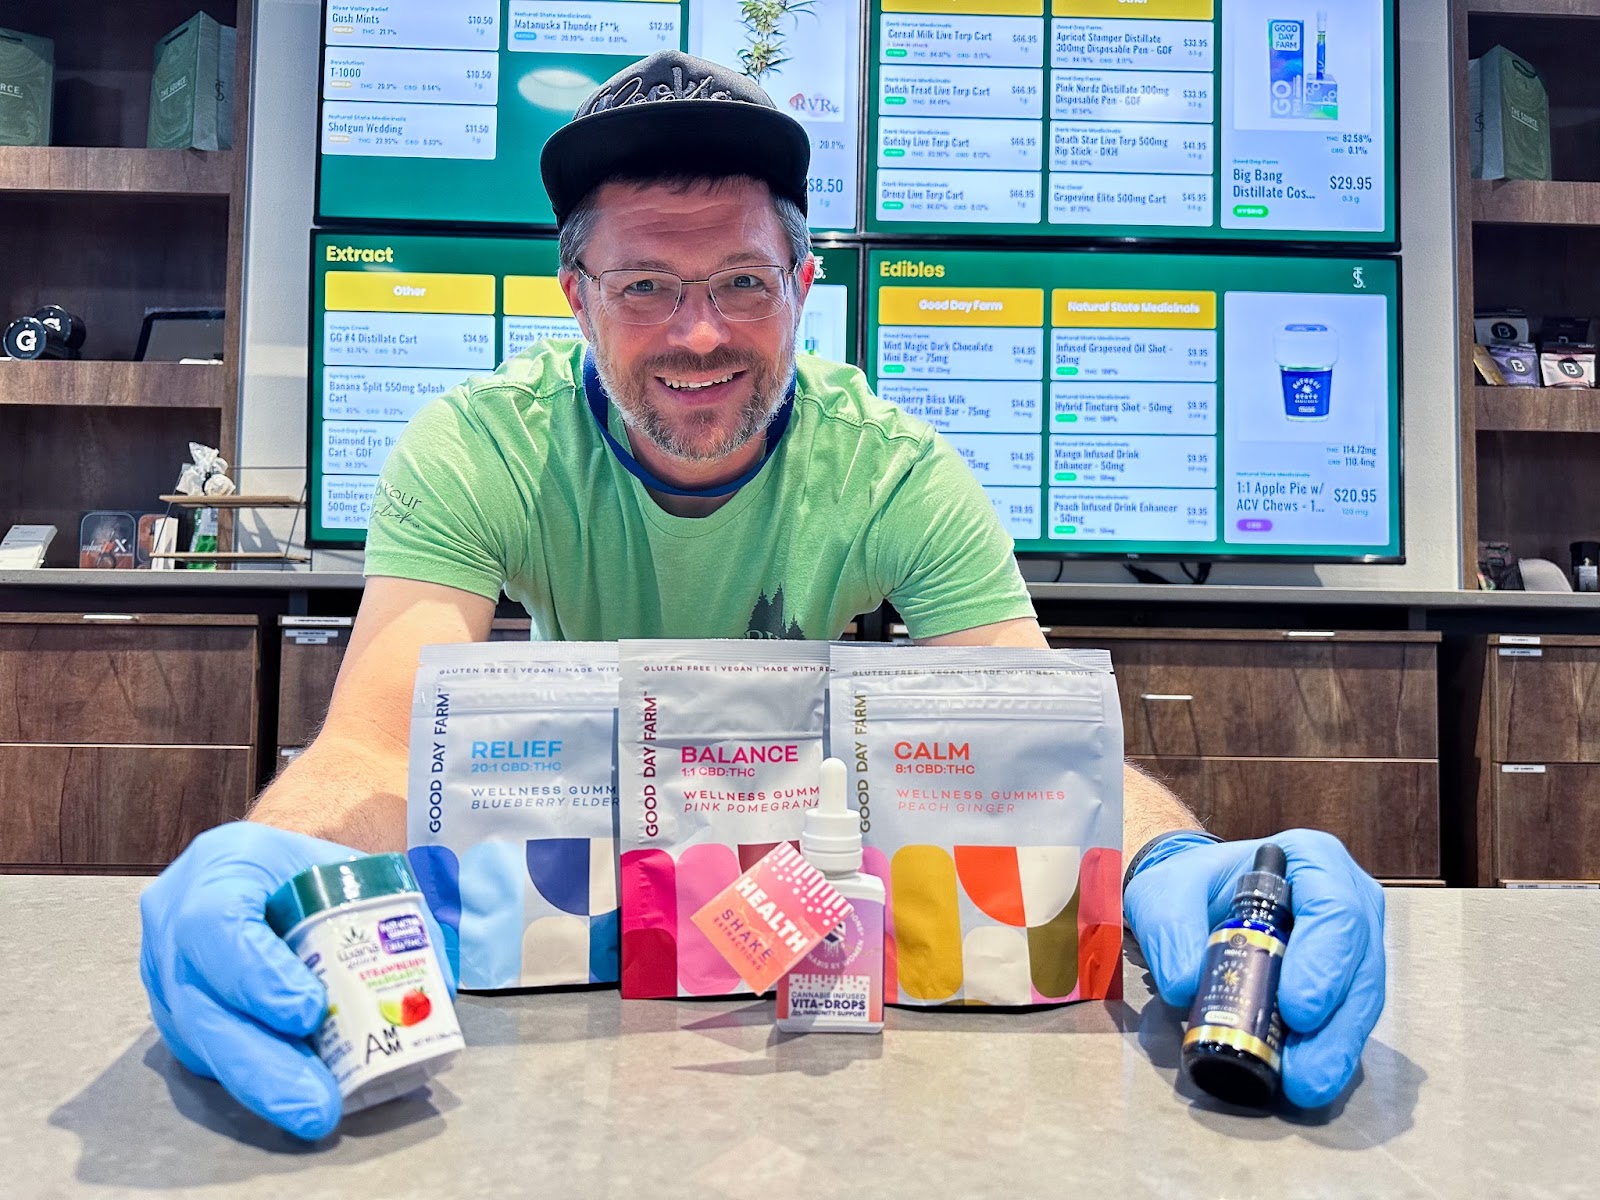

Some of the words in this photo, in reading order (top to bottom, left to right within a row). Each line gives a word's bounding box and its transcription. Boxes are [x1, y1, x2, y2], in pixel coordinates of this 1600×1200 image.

[332, 13, 353, 24] Gush
[356, 14, 380, 24] Mints
[468, 16, 493, 25] $10.50
[514, 20, 561, 30] Matanuska
[563, 21, 597, 31] Thunder
[1274, 25, 1298, 33] GOOD
[1278, 33, 1294, 41] DAY
[330, 68, 361, 78] T-1000
[466, 70, 492, 79] $10.50
[328, 122, 363, 134] Shotgun
[366, 123, 403, 135] Wedding
[464, 124, 489, 134] $11.50
[1342, 134, 1372, 143] 82.58%
[1233, 169, 1251, 183] Big
[1254, 169, 1283, 184] Bang
[808, 178, 844, 193] $8.50
[1329, 176, 1372, 191] $29.95
[1233, 185, 1283, 199] Distillate
[326, 245, 393, 263] Extract
[879, 260, 945, 277] Edibles
[393, 285, 427, 296] Other
[918, 299, 949, 310] Good
[950, 300, 972, 313] Day
[973, 300, 1003, 311] Farm
[1067, 301, 1110, 312] Natural
[1111, 302, 1140, 312] State
[1141, 302, 1200, 314] Medicinals
[16, 329, 37, 351] G
[358, 333, 397, 344] Distillate
[399, 334, 417, 345] Cart
[463, 333, 488, 344] $34.95
[1510, 359, 1526, 373] B
[1562, 362, 1579, 375] B
[329, 381, 360, 391] Banana
[363, 381, 382, 393] Split
[385, 382, 415, 394] 550mg
[417, 383, 445, 394] Splash
[329, 393, 347, 403] Cart
[328, 435, 365, 446] Diamond
[328, 448, 346, 457] Cart
[1236, 481, 1251, 495] 1:1
[1254, 482, 1285, 496] Apple
[1289, 482, 1307, 495] Pie
[1310, 482, 1324, 495] w/
[1334, 488, 1377, 503] $20.95
[328, 502, 357, 513] 500mg
[1236, 499, 1258, 512] ACV
[1262, 499, 1298, 512] Chews
[439, 667, 479, 675] GLUTEN
[471, 740, 563, 759] RELIEF
[681, 745, 799, 764] BALANCE
[894, 742, 970, 760] CALM
[431, 742, 445, 774] DAY
[643, 747, 656, 778] DAY
[855, 742, 868, 773] DAY
[471, 763, 498, 773] 20:1
[501, 762, 561, 772] CBD:THC
[681, 768, 696, 777] 1:1
[699, 767, 755, 777] CBD:THC
[895, 764, 913, 774] 8:1
[916, 764, 975, 775] CBD:THC
[471, 786, 561, 797] WELLNESS
[569, 785, 617, 795] GUMM
[684, 790, 766, 801] WELLNESS
[773, 787, 820, 799] GUMM
[896, 788, 983, 801] WELLNESS
[991, 789, 1065, 801] GUMMIES
[429, 779, 443, 833] GOOD
[471, 798, 565, 809] BLUEBERRY
[572, 797, 619, 807] ELDER
[684, 802, 720, 813] PINK
[728, 799, 820, 813] POMEGRANA
[856, 780, 871, 833] GOOD
[898, 802, 948, 812] PEACH
[957, 803, 1015, 813] GINGER
[644, 785, 659, 837] GOOD
[735, 876, 809, 954] HEALTH
[722, 908, 775, 962] SHAKE
[791, 991, 830, 999] CANNABIS
[791, 999, 866, 1010] VITA-DROPS
